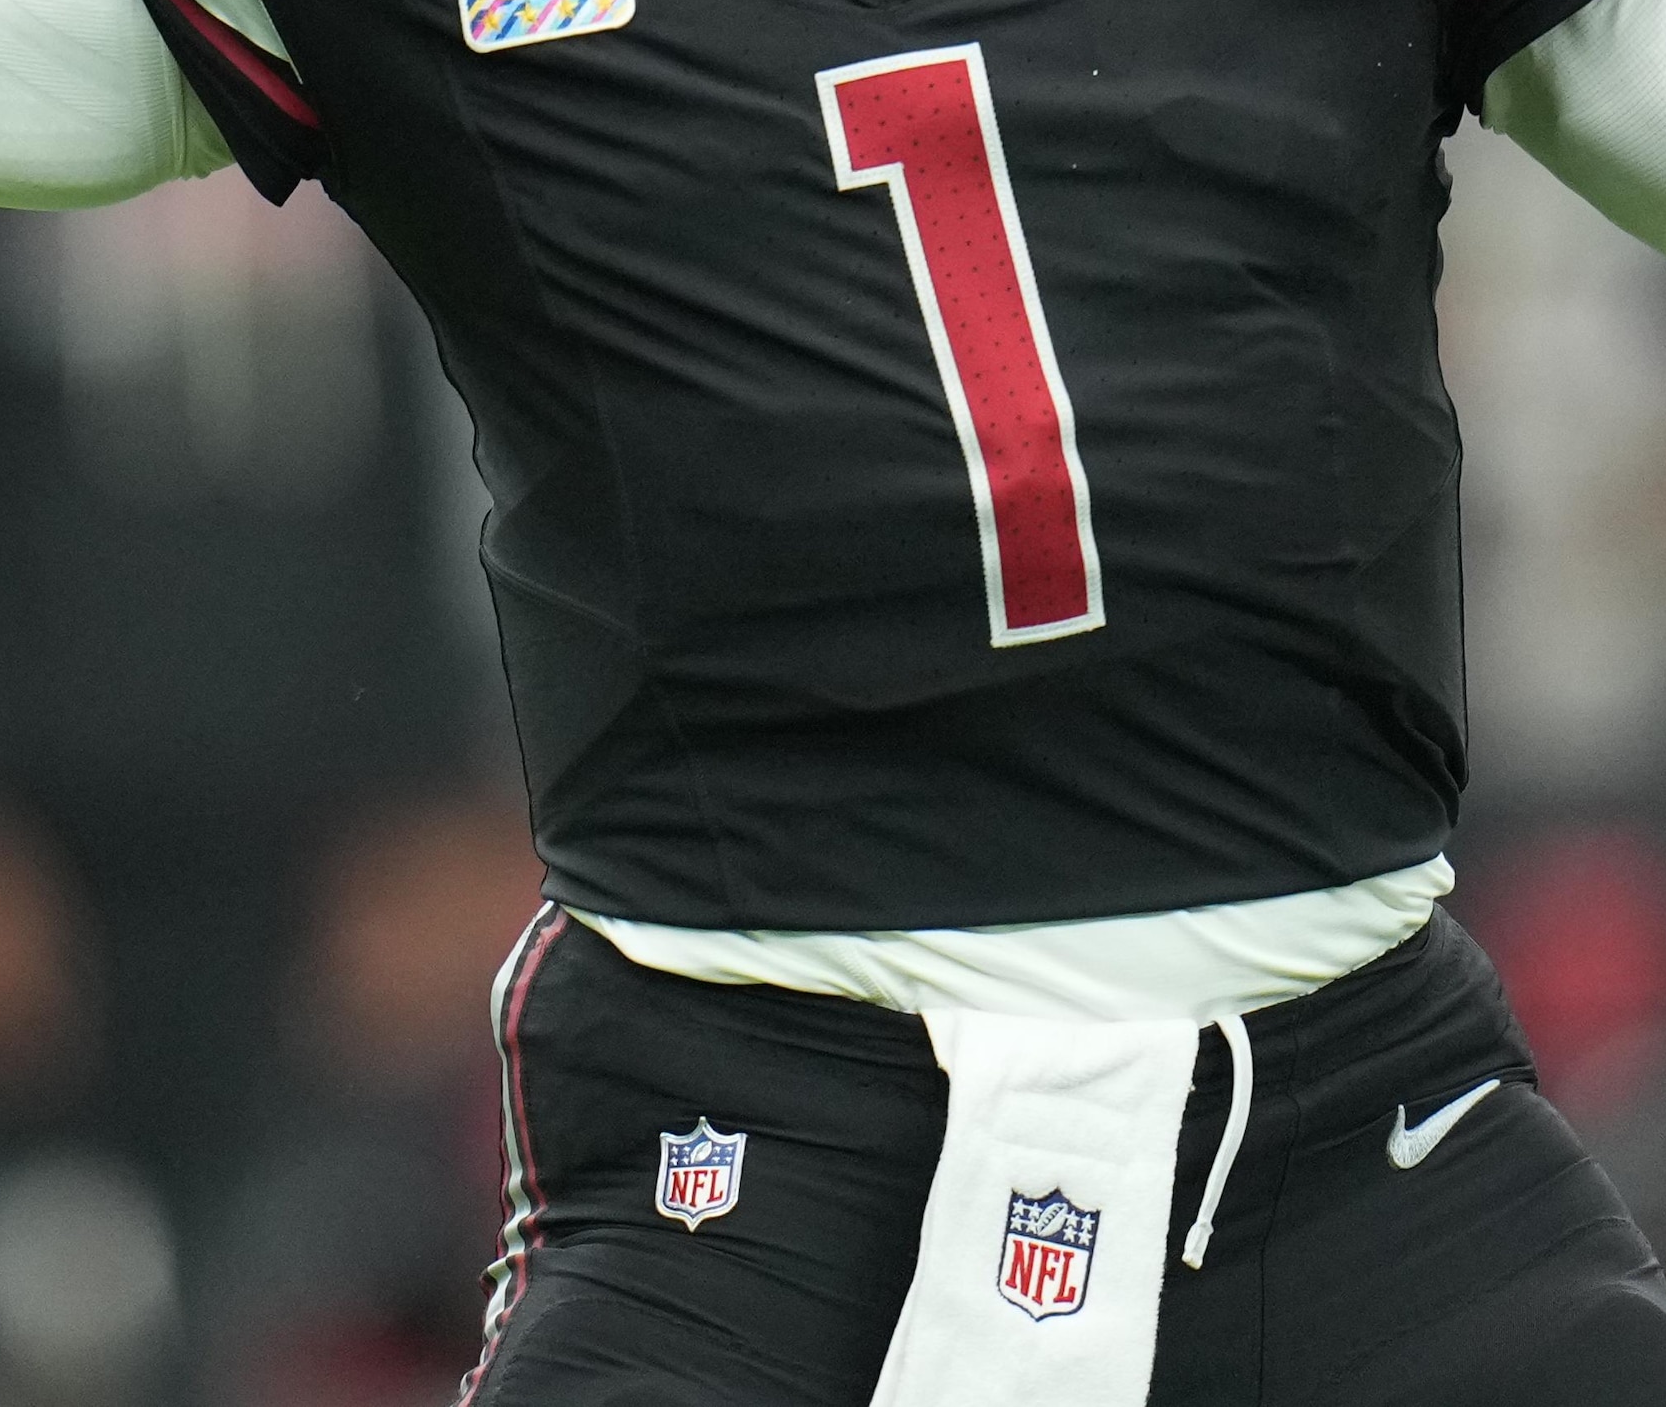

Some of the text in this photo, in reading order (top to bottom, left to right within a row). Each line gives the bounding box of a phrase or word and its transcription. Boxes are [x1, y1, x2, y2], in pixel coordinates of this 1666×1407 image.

[815, 42, 1106, 648] 1
[668, 1169, 724, 1207] NFL
[1004, 1239, 1077, 1306] NFL
